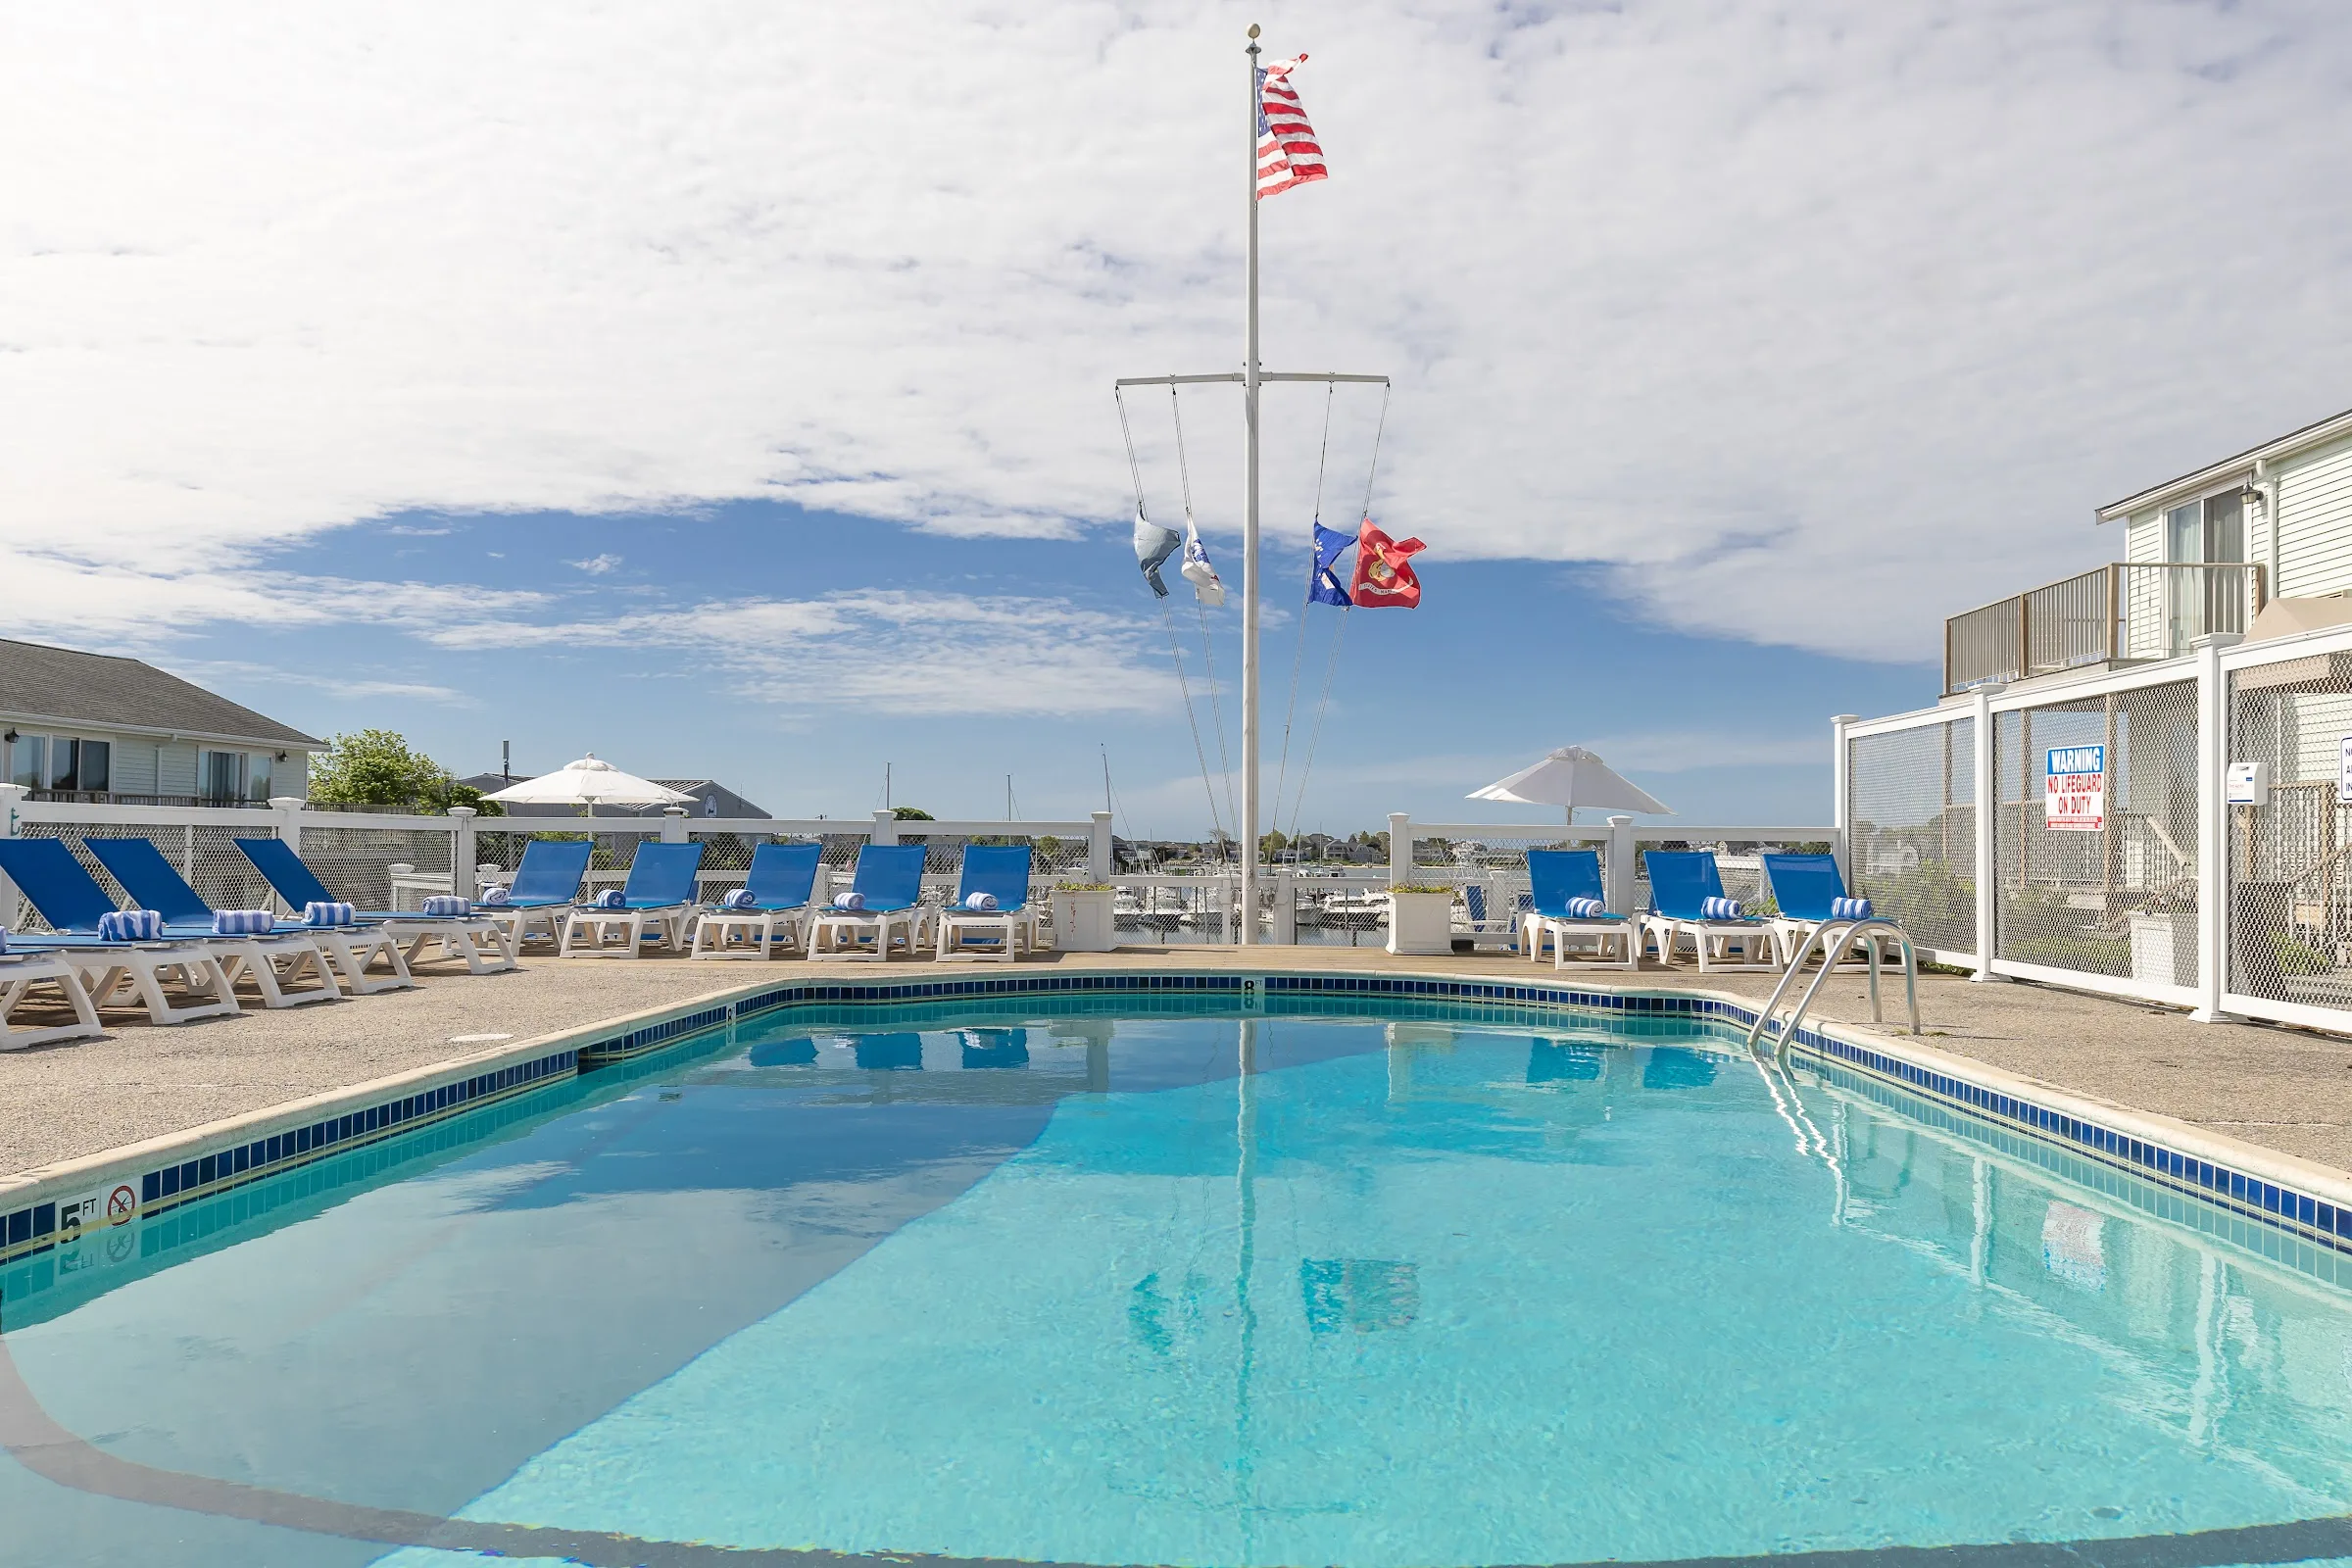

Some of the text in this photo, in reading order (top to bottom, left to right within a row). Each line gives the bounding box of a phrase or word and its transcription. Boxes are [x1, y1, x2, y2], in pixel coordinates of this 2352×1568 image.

[2051, 747, 2100, 773] WARNING
[2345, 748, 2352, 757] N
[2048, 773, 2102, 794] NO LIFEGUARD
[2058, 795, 2091, 814] ON DUTY
[1245, 980, 1254, 994] 8
[61, 1199, 96, 1244] 5 FT
